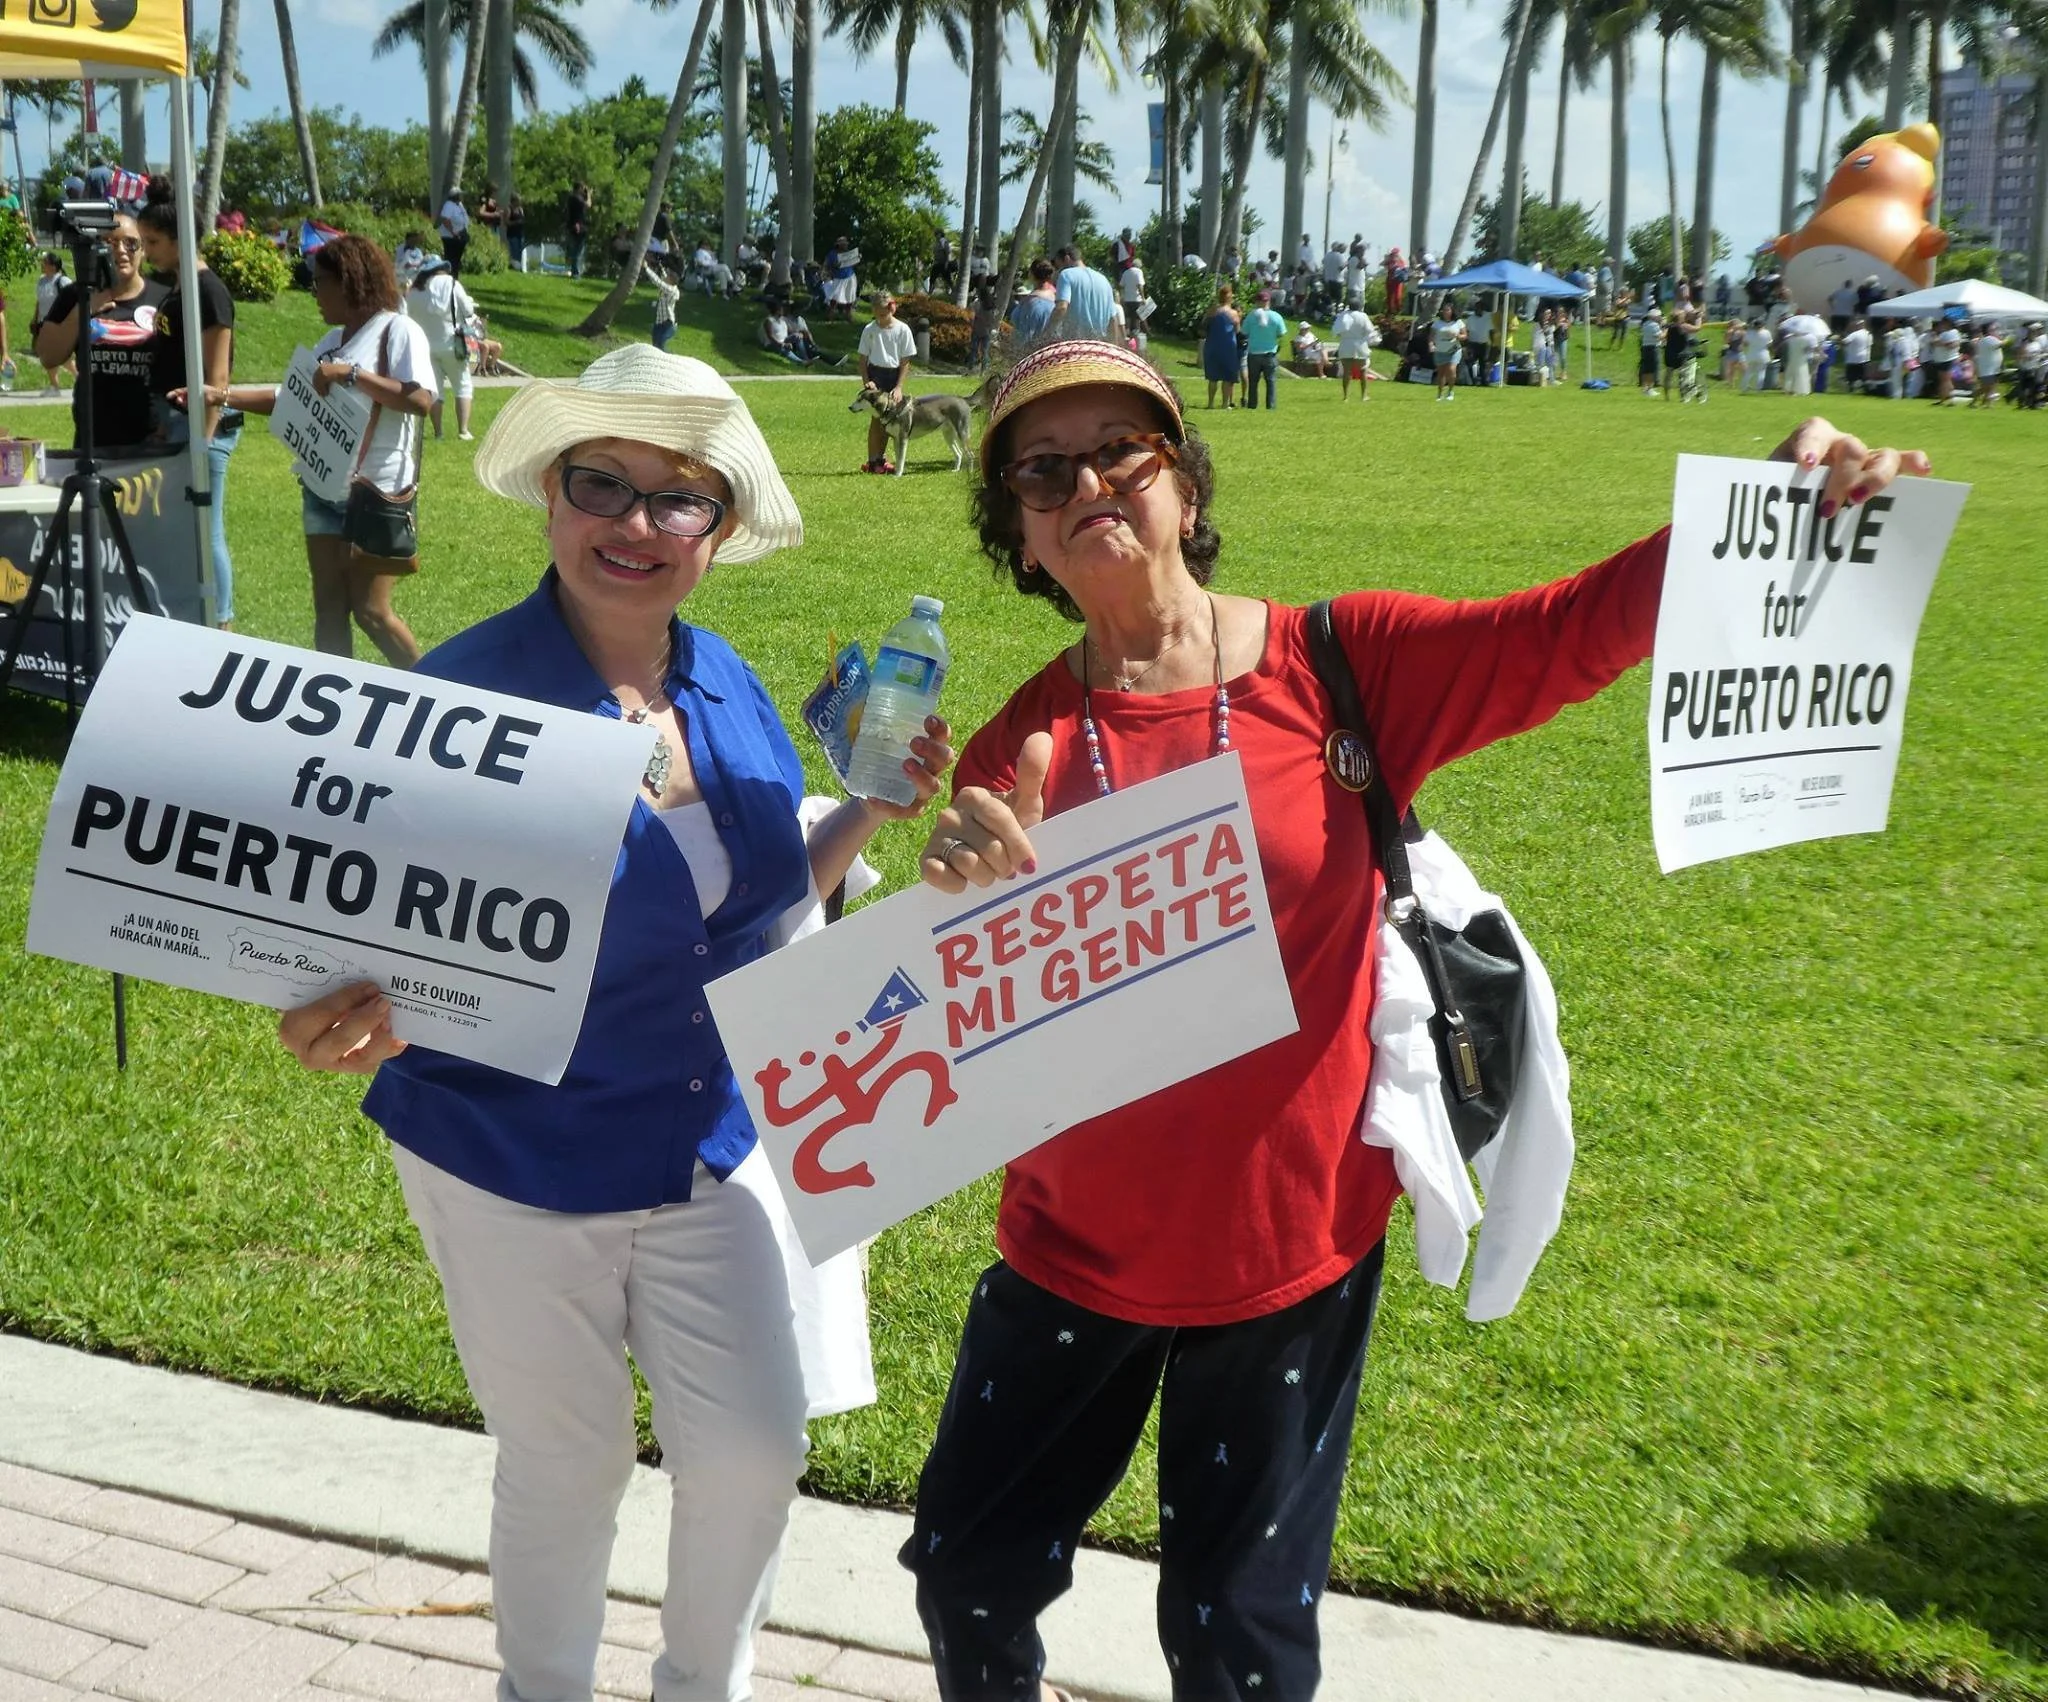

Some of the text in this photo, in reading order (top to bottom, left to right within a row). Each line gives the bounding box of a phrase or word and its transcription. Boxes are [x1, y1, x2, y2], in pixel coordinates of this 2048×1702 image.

[131, 351, 154, 364] RIC
[287, 374, 312, 408] RICO
[284, 422, 332, 482] JUSTICE
[305, 423, 320, 444] for
[311, 400, 355, 455] PUERTO
[1712, 482, 1896, 564] JUSTICE
[1763, 580, 1807, 638] for
[179, 652, 543, 785] JUSTICE
[1662, 662, 1894, 743] PUERTO RICO
[290, 757, 393, 824] for
[71, 784, 571, 963] PUERTO RICO
[138, 915, 153, 930] UN
[155, 917, 178, 936] AÑO
[181, 928, 200, 942] DEL
[935, 823, 1244, 989] RESPETA
[110, 925, 211, 961] HURACÁN MARÍA...
[239, 941, 329, 975] Puerto Rico
[944, 872, 1253, 1049] MI GENTE
[391, 975, 481, 1011] NO SE OLVIDA!
[447, 1015, 478, 1029] 9.22.2018
